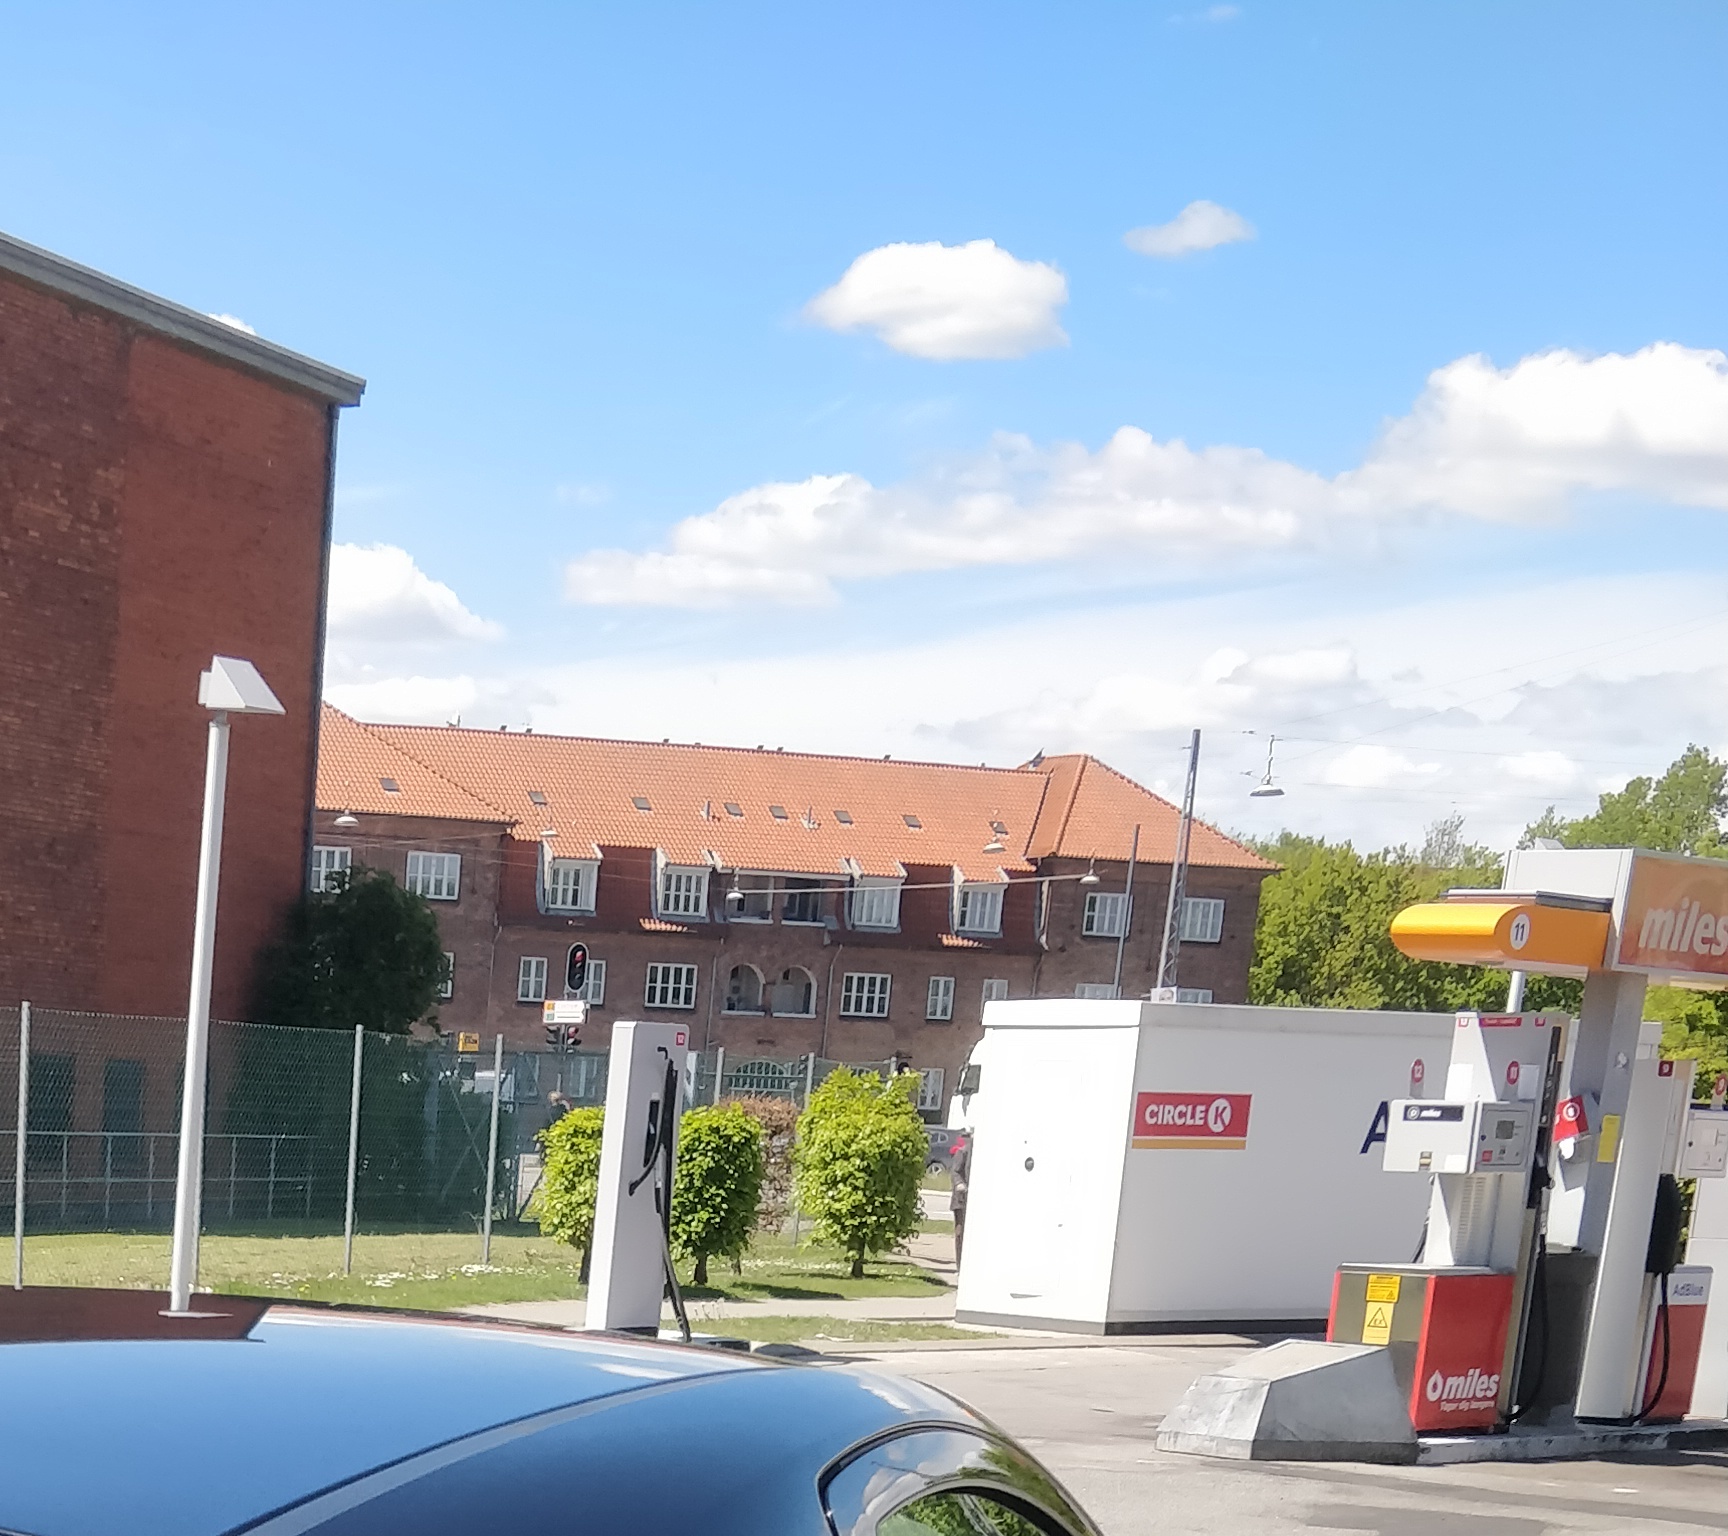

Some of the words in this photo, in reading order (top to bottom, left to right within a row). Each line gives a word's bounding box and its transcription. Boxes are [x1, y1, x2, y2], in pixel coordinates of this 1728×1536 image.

[1513, 921, 1525, 942] 11
[1638, 897, 1728, 956] miles
[1144, 1103, 1207, 1126] CIRCLE
[1441, 1368, 1500, 1400] miles
